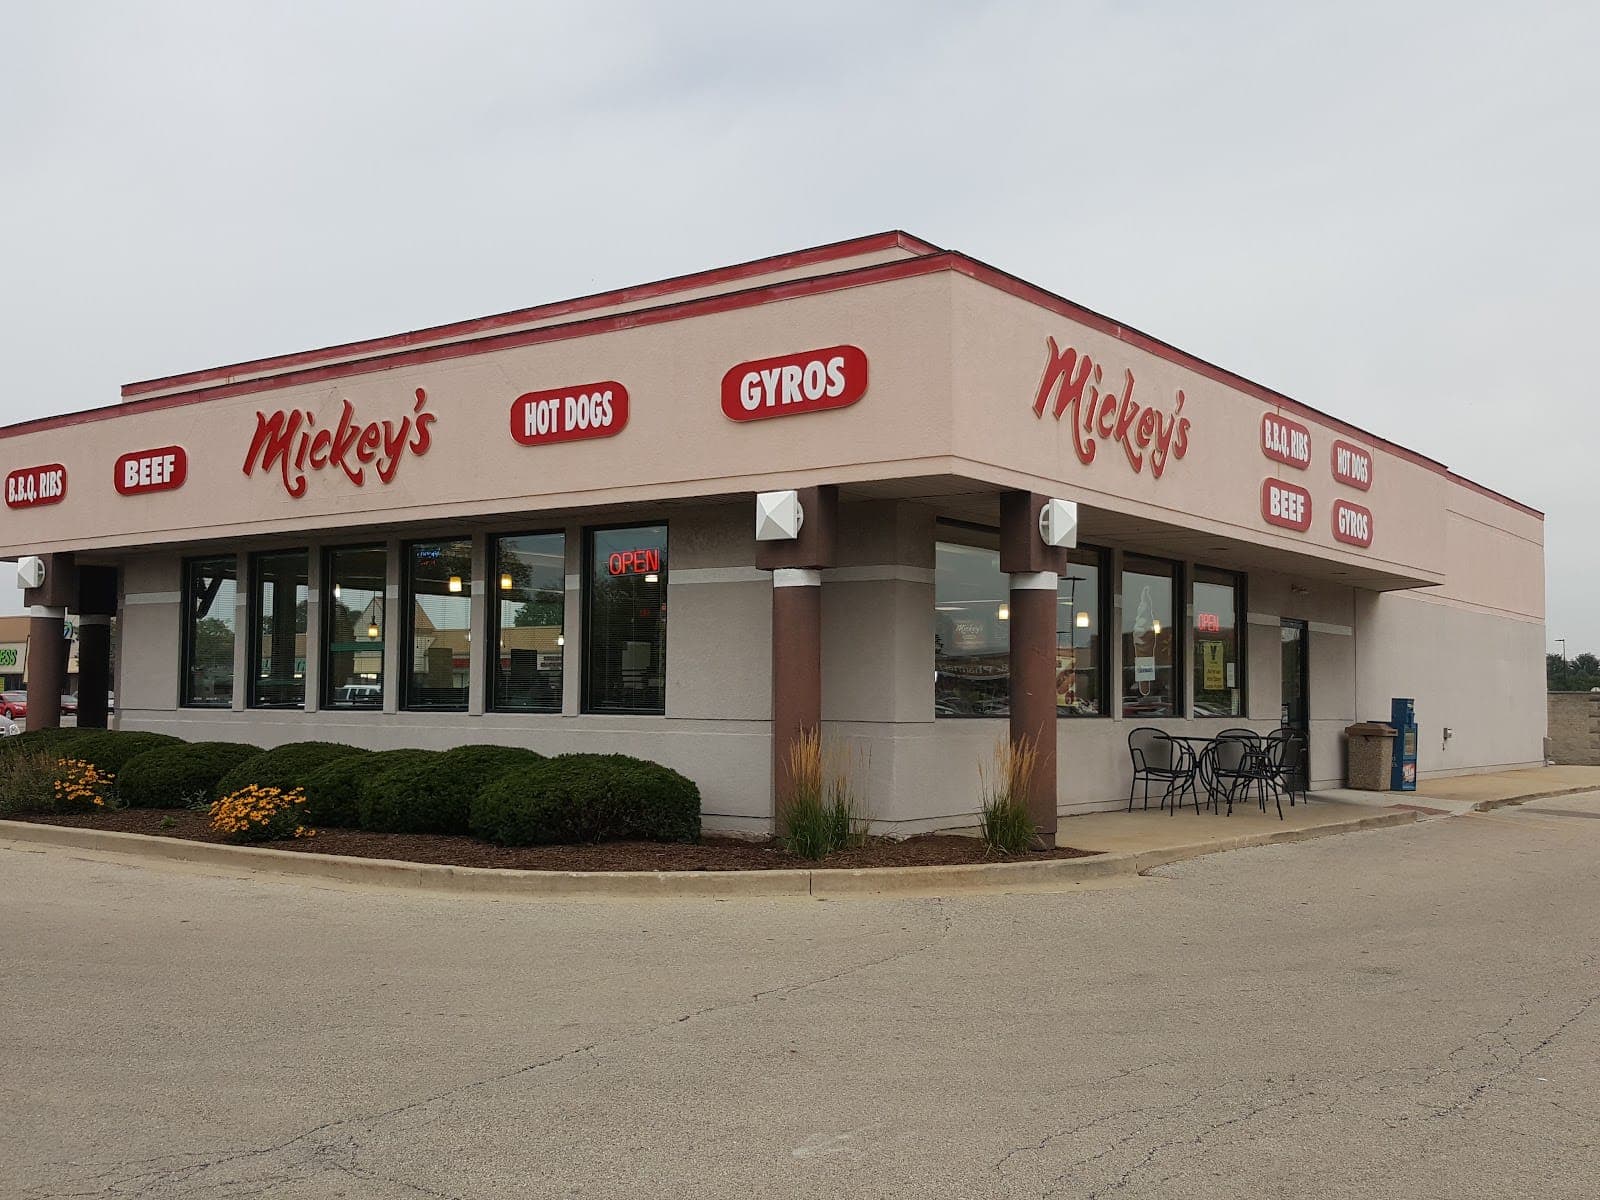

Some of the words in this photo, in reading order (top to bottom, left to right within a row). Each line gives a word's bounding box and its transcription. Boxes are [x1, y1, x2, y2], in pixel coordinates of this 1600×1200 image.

[740, 356, 845, 411] GYROS
[525, 399, 560, 437] HOT
[564, 391, 613, 431] DOGS
[1032, 335, 1191, 479] Mickey's
[242, 387, 437, 498] Mickey's
[1265, 419, 1290, 458] B.B.Q.
[1290, 429, 1308, 462] RIBS
[124, 454, 175, 488] BEEF
[1337, 447, 1351, 477] HOT
[1351, 453, 1368, 483] DOGS
[8, 474, 37, 503] B.B.Q.
[39, 470, 63, 498] RIBS
[1270, 486, 1304, 523] BEEF
[1338, 506, 1368, 541] GYROS
[609, 549, 659, 575] OPEN
[1198, 613, 1219, 632] OPEN
